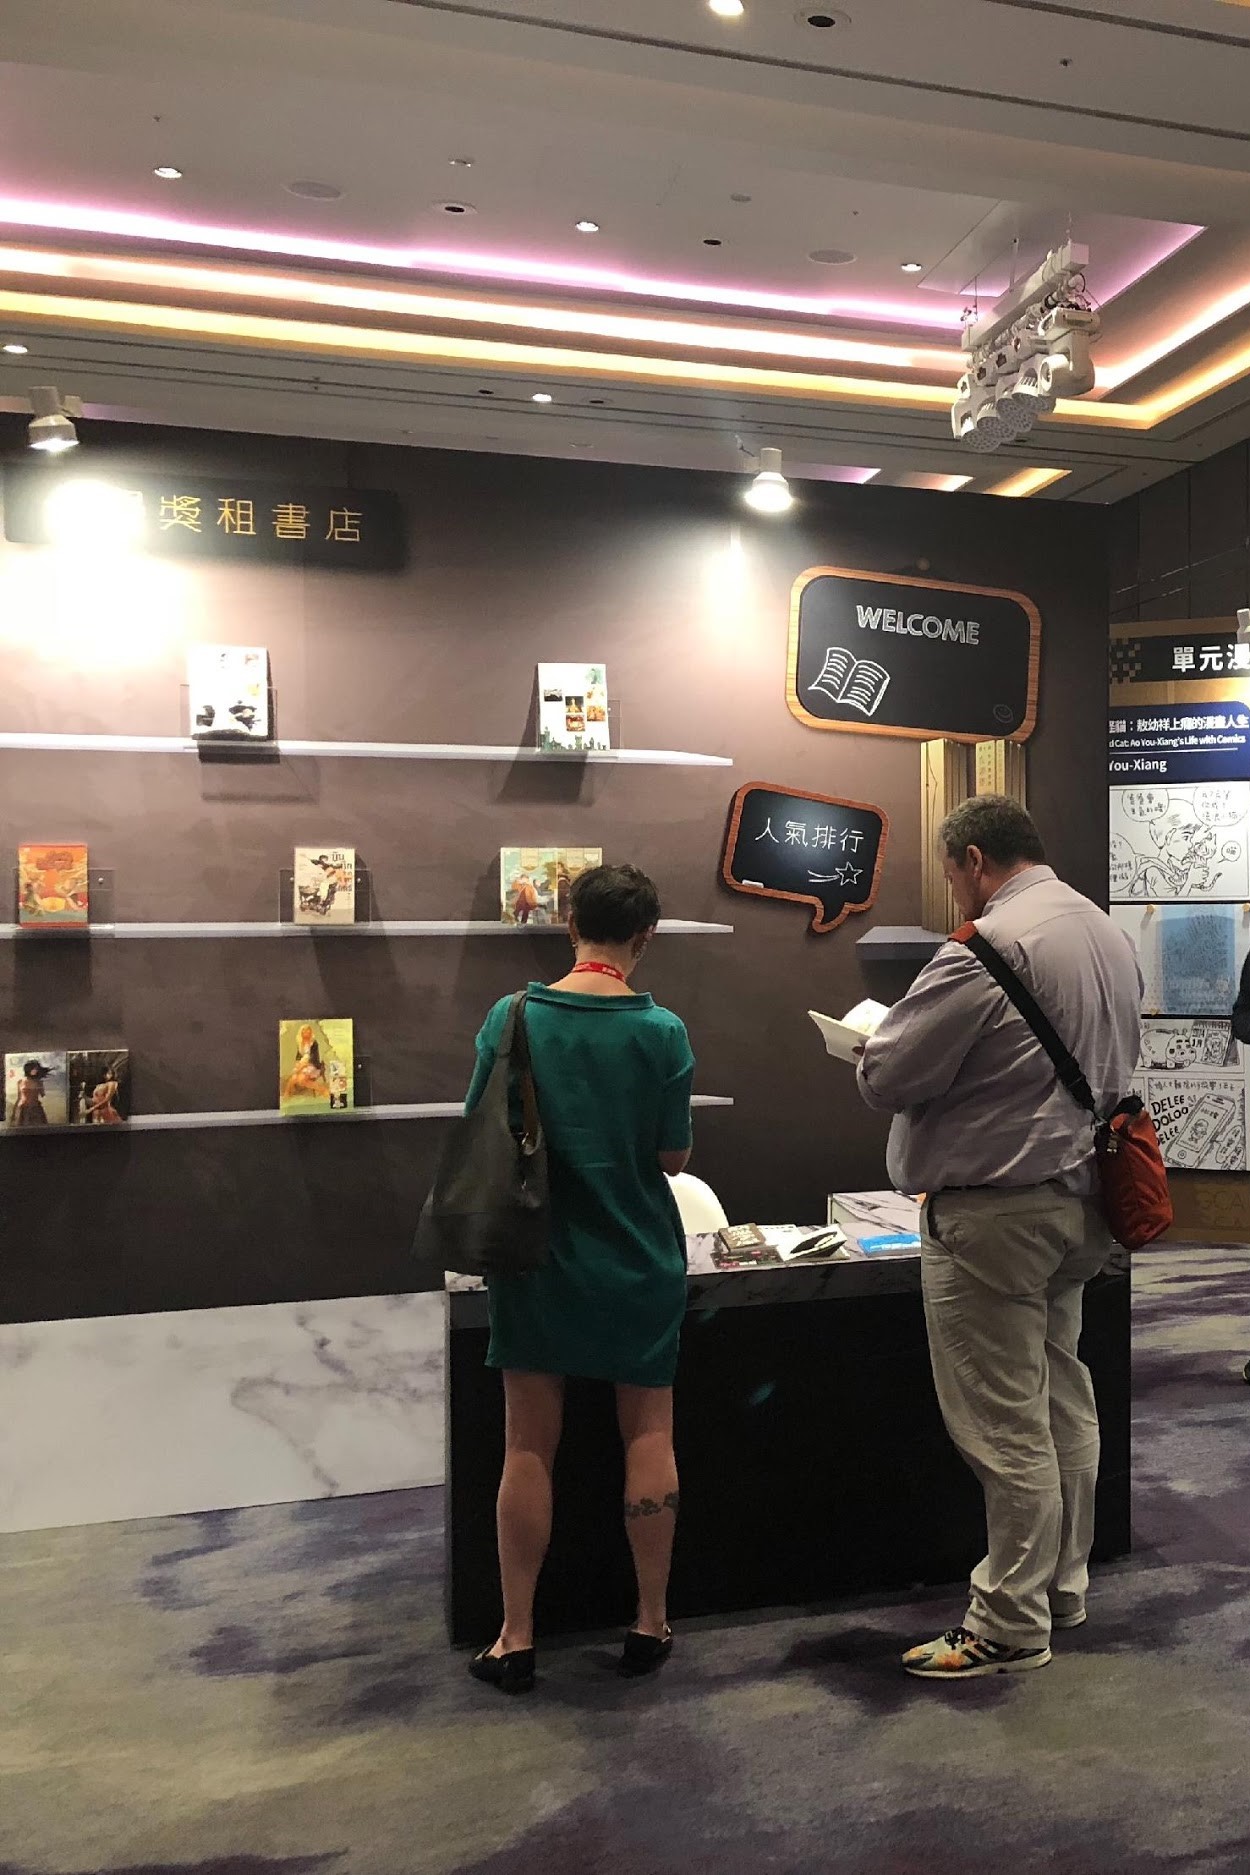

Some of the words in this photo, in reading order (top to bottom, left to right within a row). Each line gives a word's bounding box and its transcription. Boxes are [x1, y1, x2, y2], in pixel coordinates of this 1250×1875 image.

[120, 490, 363, 542] 獎租書店
[856, 605, 980, 645] WELCOME
[1185, 736, 1198, 745] Life
[1199, 735, 1216, 745] with
[1217, 734, 1246, 744] Comics
[754, 817, 864, 854] 人氣排行
[1151, 1095, 1185, 1116] DELEE
